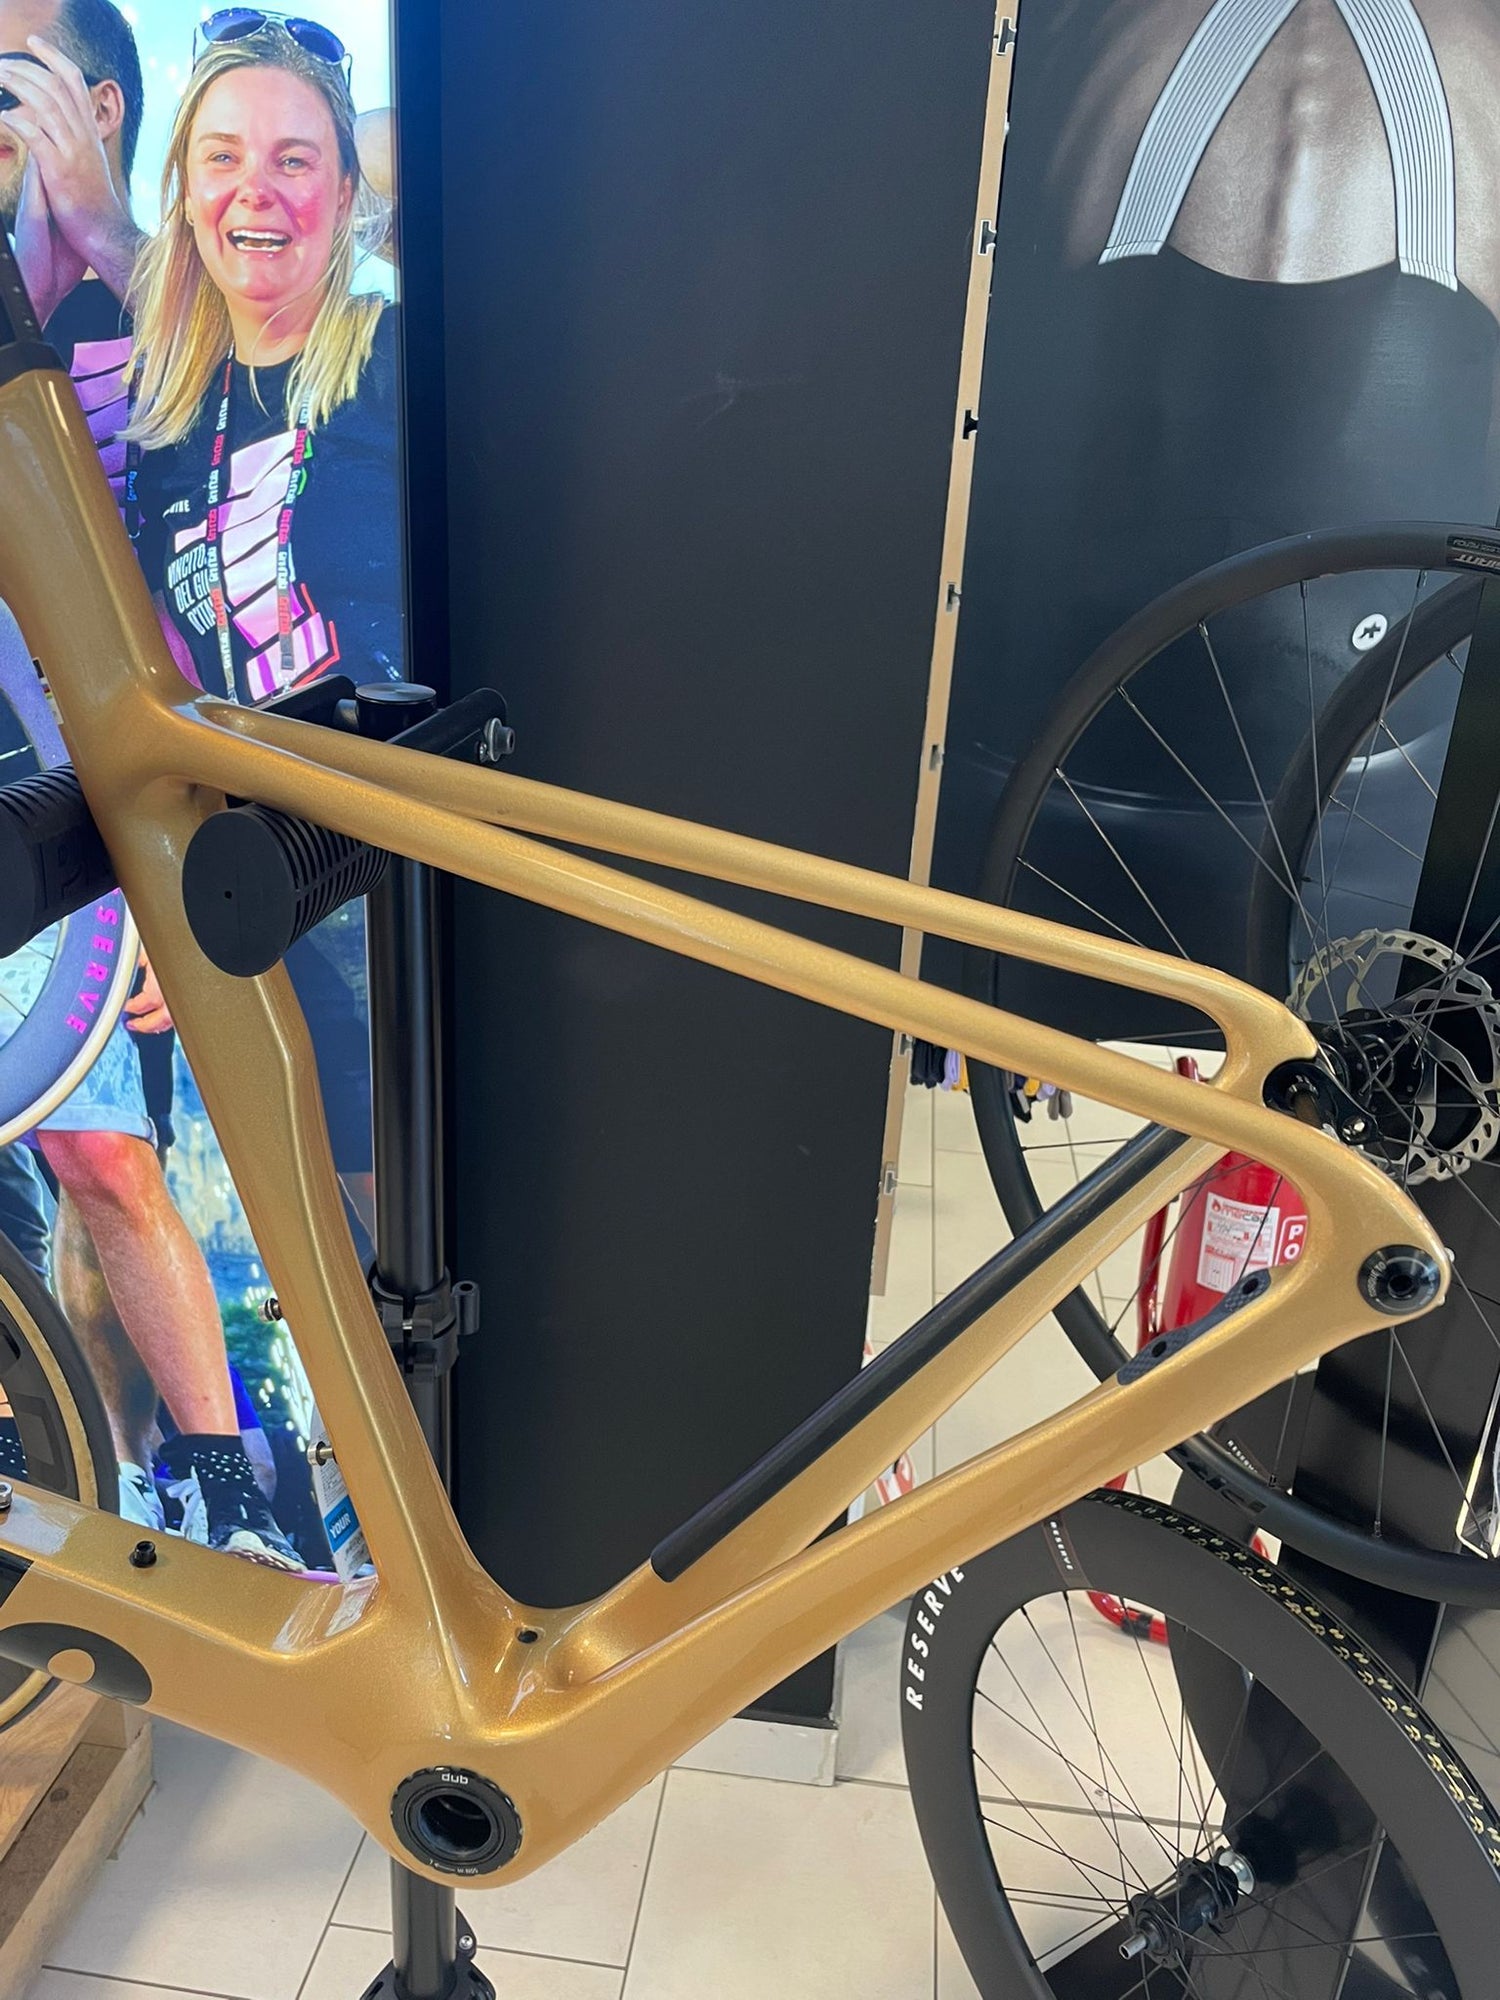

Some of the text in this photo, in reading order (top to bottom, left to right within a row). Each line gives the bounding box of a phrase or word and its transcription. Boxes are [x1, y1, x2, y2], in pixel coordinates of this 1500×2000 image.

[64, 888, 119, 1035] SERVE
[905, 1566, 965, 1711] RESERVE
[441, 1773, 469, 1785] dub
